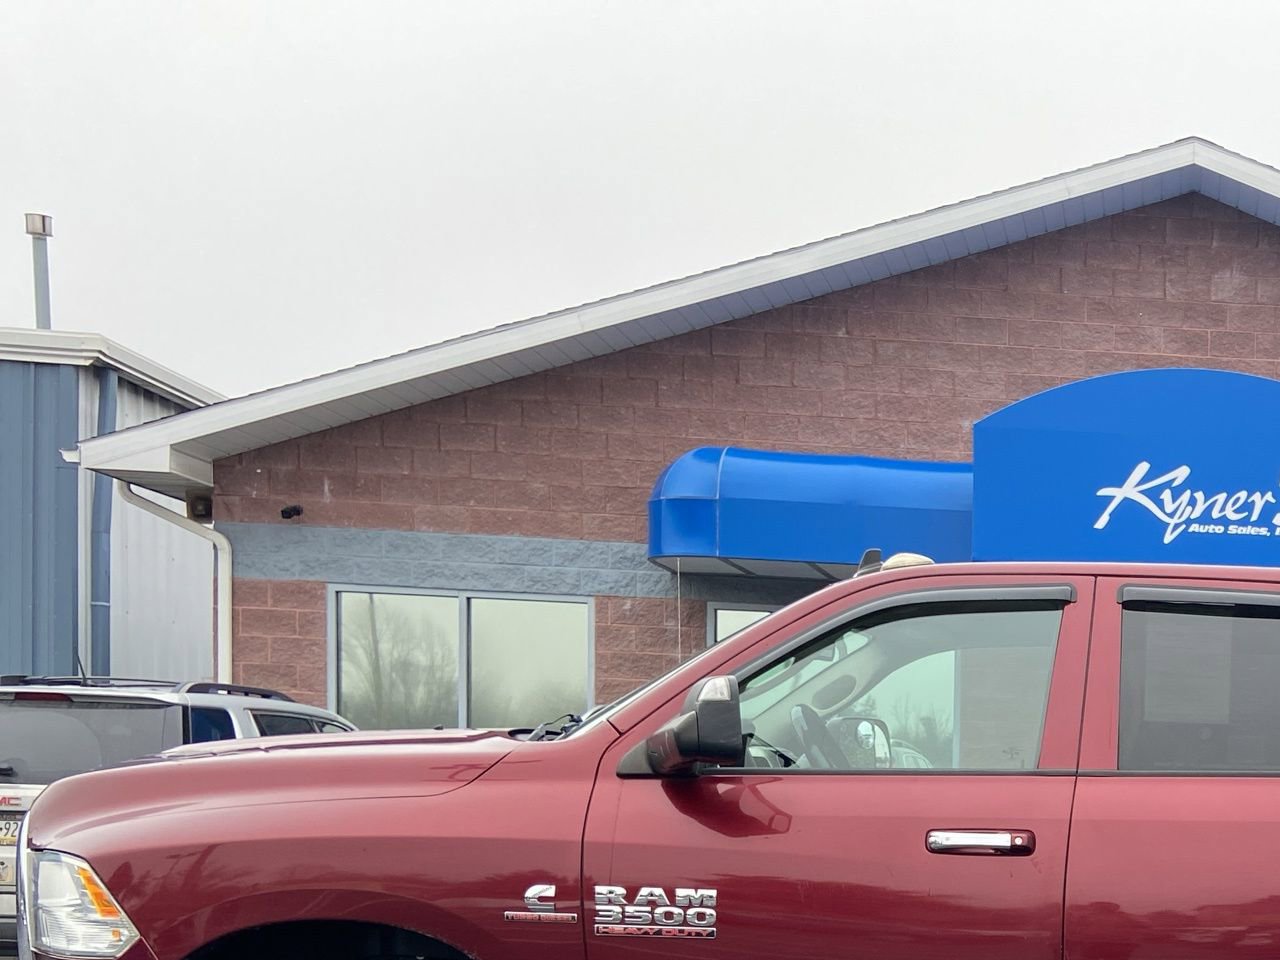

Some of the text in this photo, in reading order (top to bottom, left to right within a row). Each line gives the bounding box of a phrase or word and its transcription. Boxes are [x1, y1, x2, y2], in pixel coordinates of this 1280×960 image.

[1188, 523, 1224, 534] Auto
[1227, 525, 1270, 536] Sales,
[594, 885, 717, 907] RAM
[594, 905, 717, 926] 3500
[599, 926, 714, 937] HEAVY DUTY
